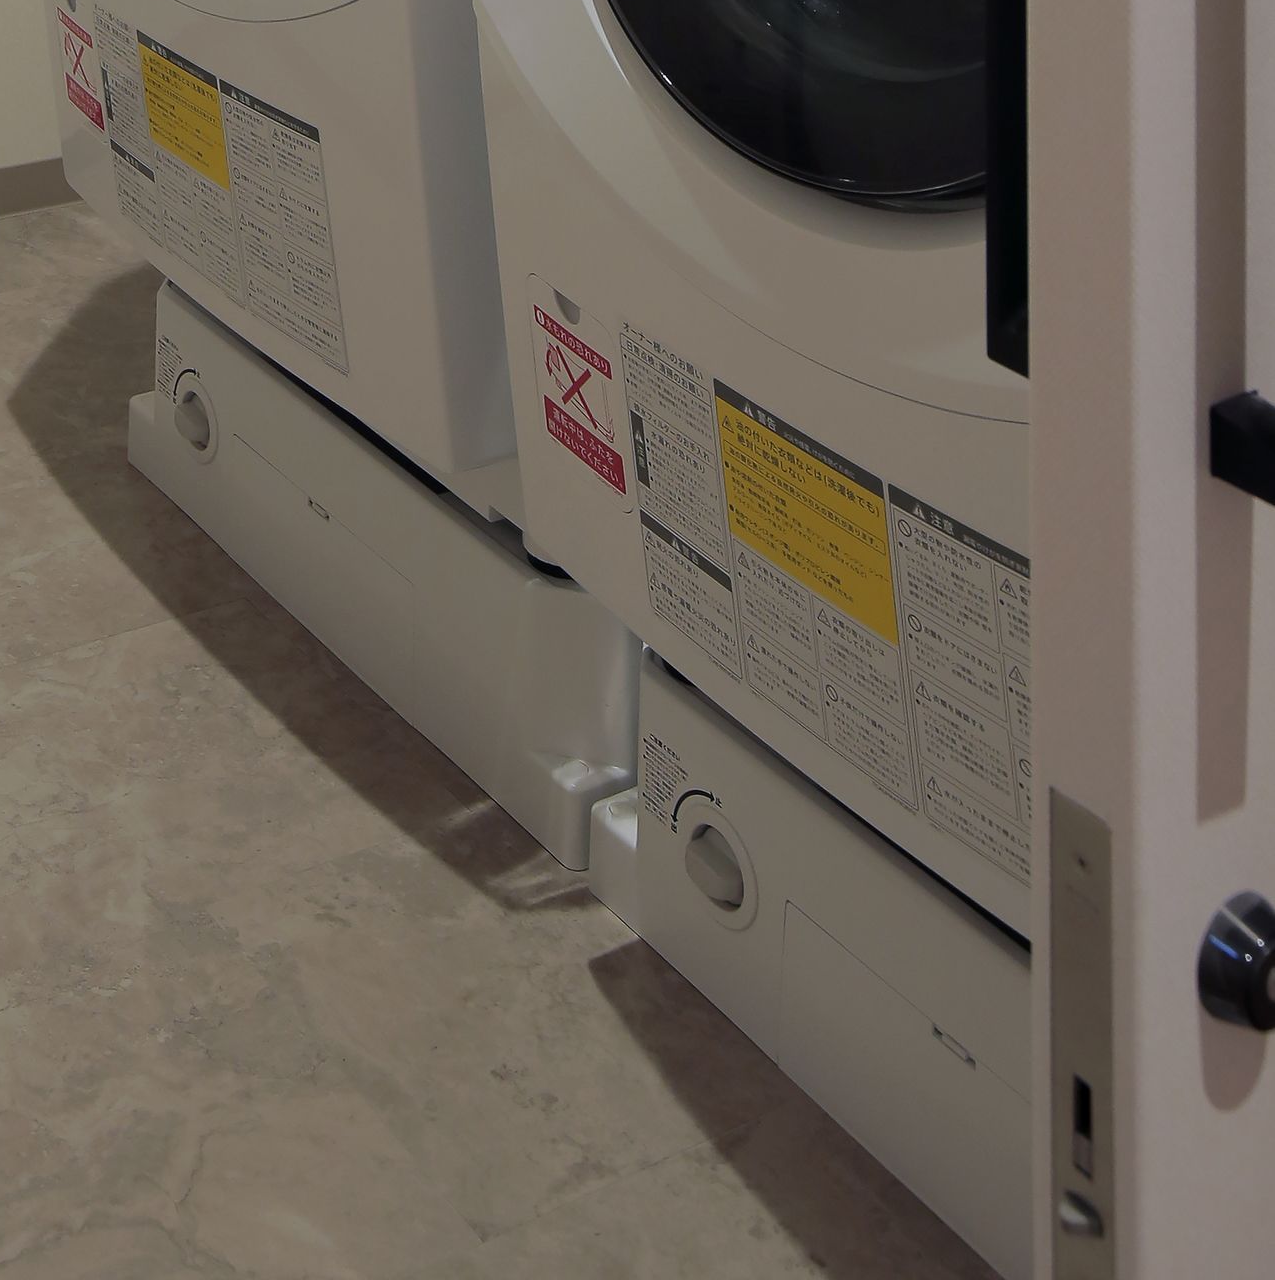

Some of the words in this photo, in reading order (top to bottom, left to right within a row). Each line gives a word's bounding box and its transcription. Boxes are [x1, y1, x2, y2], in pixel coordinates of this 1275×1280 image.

[544, 318, 609, 374] 水もれの恐れあり
[623, 322, 704, 380] オーナー様へのお願い
[552, 407, 614, 466] 運転中は、ふたを
[757, 410, 776, 432] 警告
[548, 418, 624, 489] 開けないでください。
[929, 511, 955, 536] 注意
